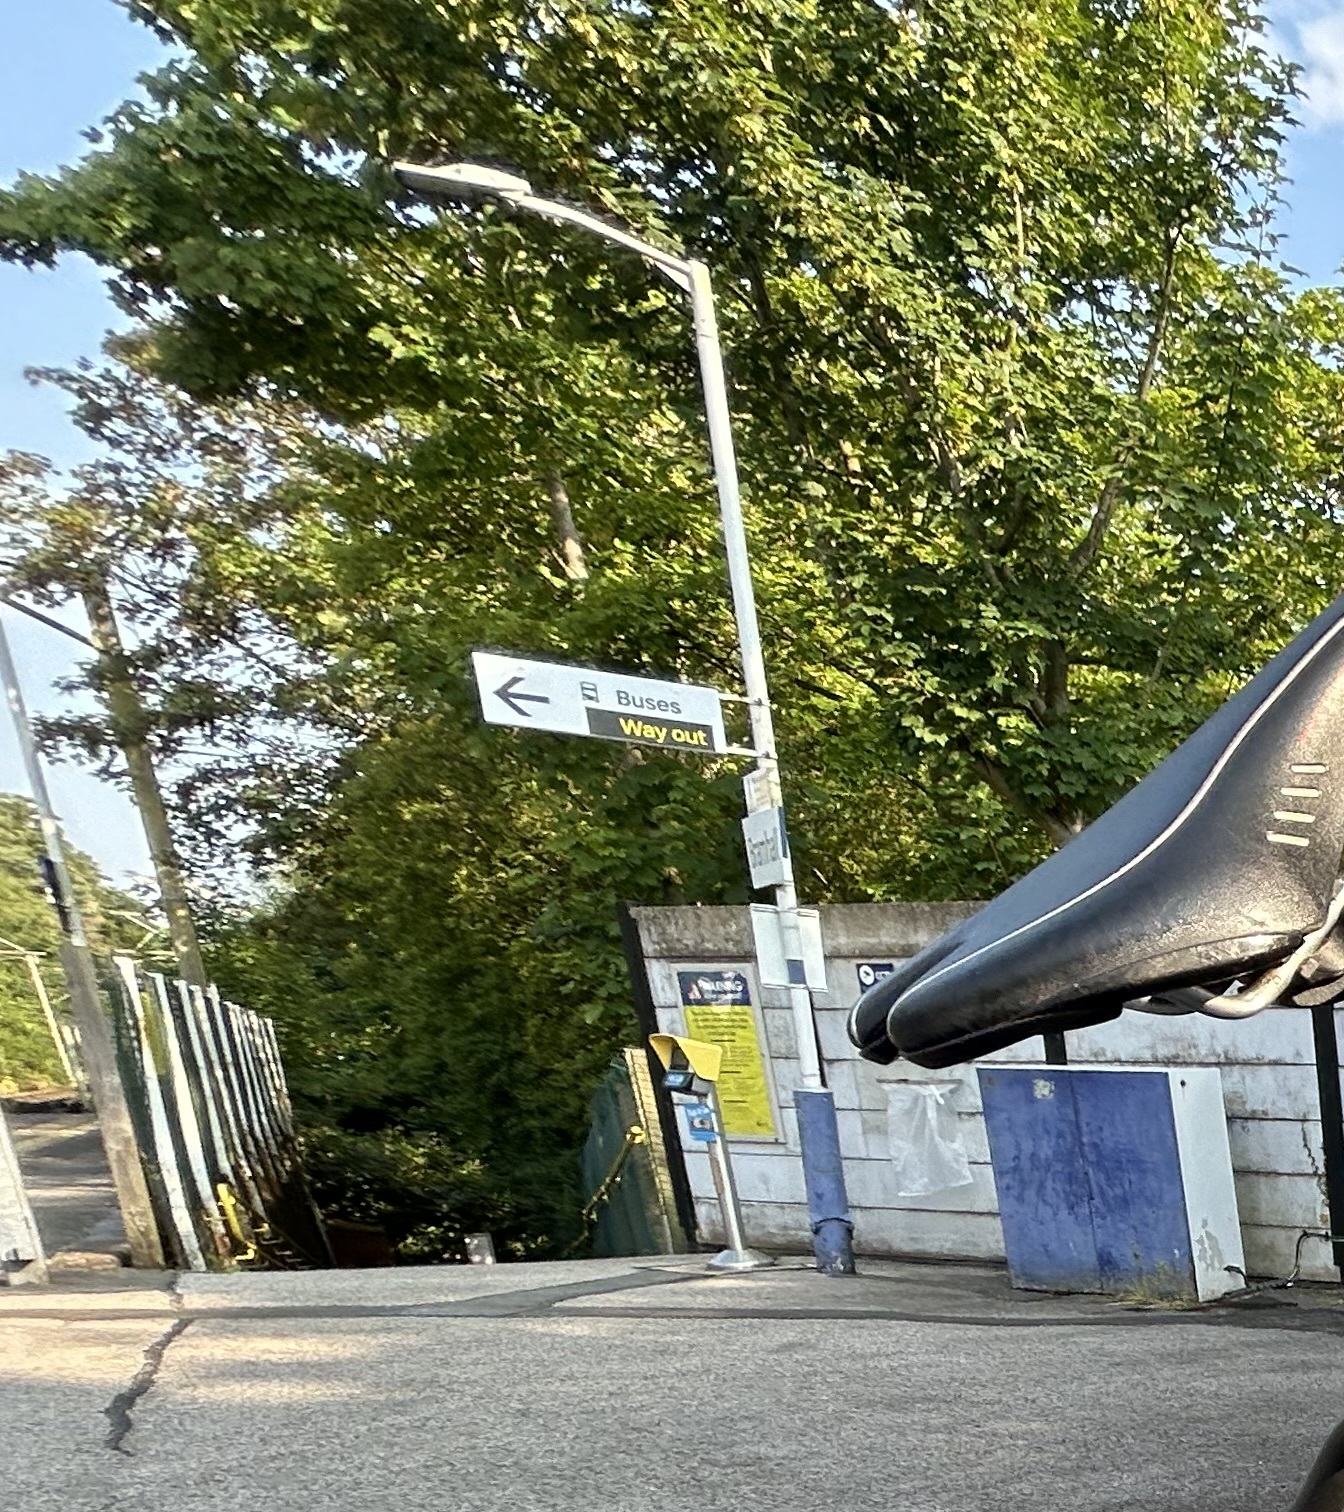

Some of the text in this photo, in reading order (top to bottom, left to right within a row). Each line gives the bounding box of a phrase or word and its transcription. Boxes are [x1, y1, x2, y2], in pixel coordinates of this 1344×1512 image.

[616, 689, 682, 714] Buses
[619, 717, 708, 746] Way out
